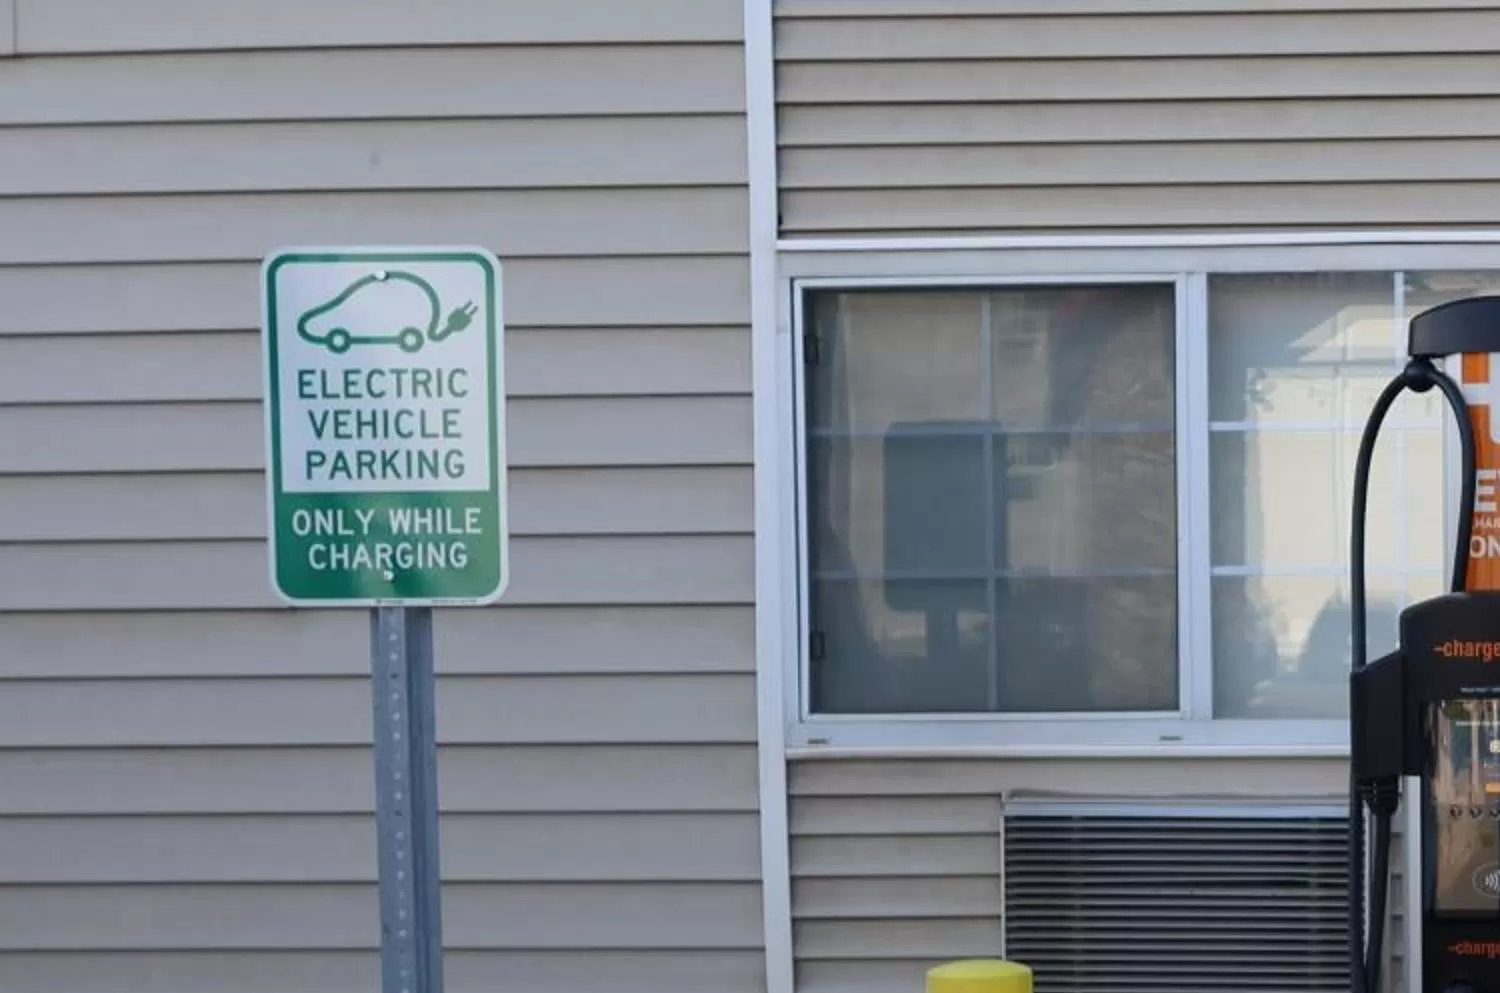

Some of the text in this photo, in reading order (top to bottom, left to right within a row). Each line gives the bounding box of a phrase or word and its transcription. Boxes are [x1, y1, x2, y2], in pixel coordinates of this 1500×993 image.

[298, 368, 469, 399] ELECTRIC
[308, 409, 463, 439] VEHICLE
[306, 450, 466, 480] PARKING
[292, 508, 483, 536] ONLY WHILE
[308, 544, 469, 570] CHARGING
